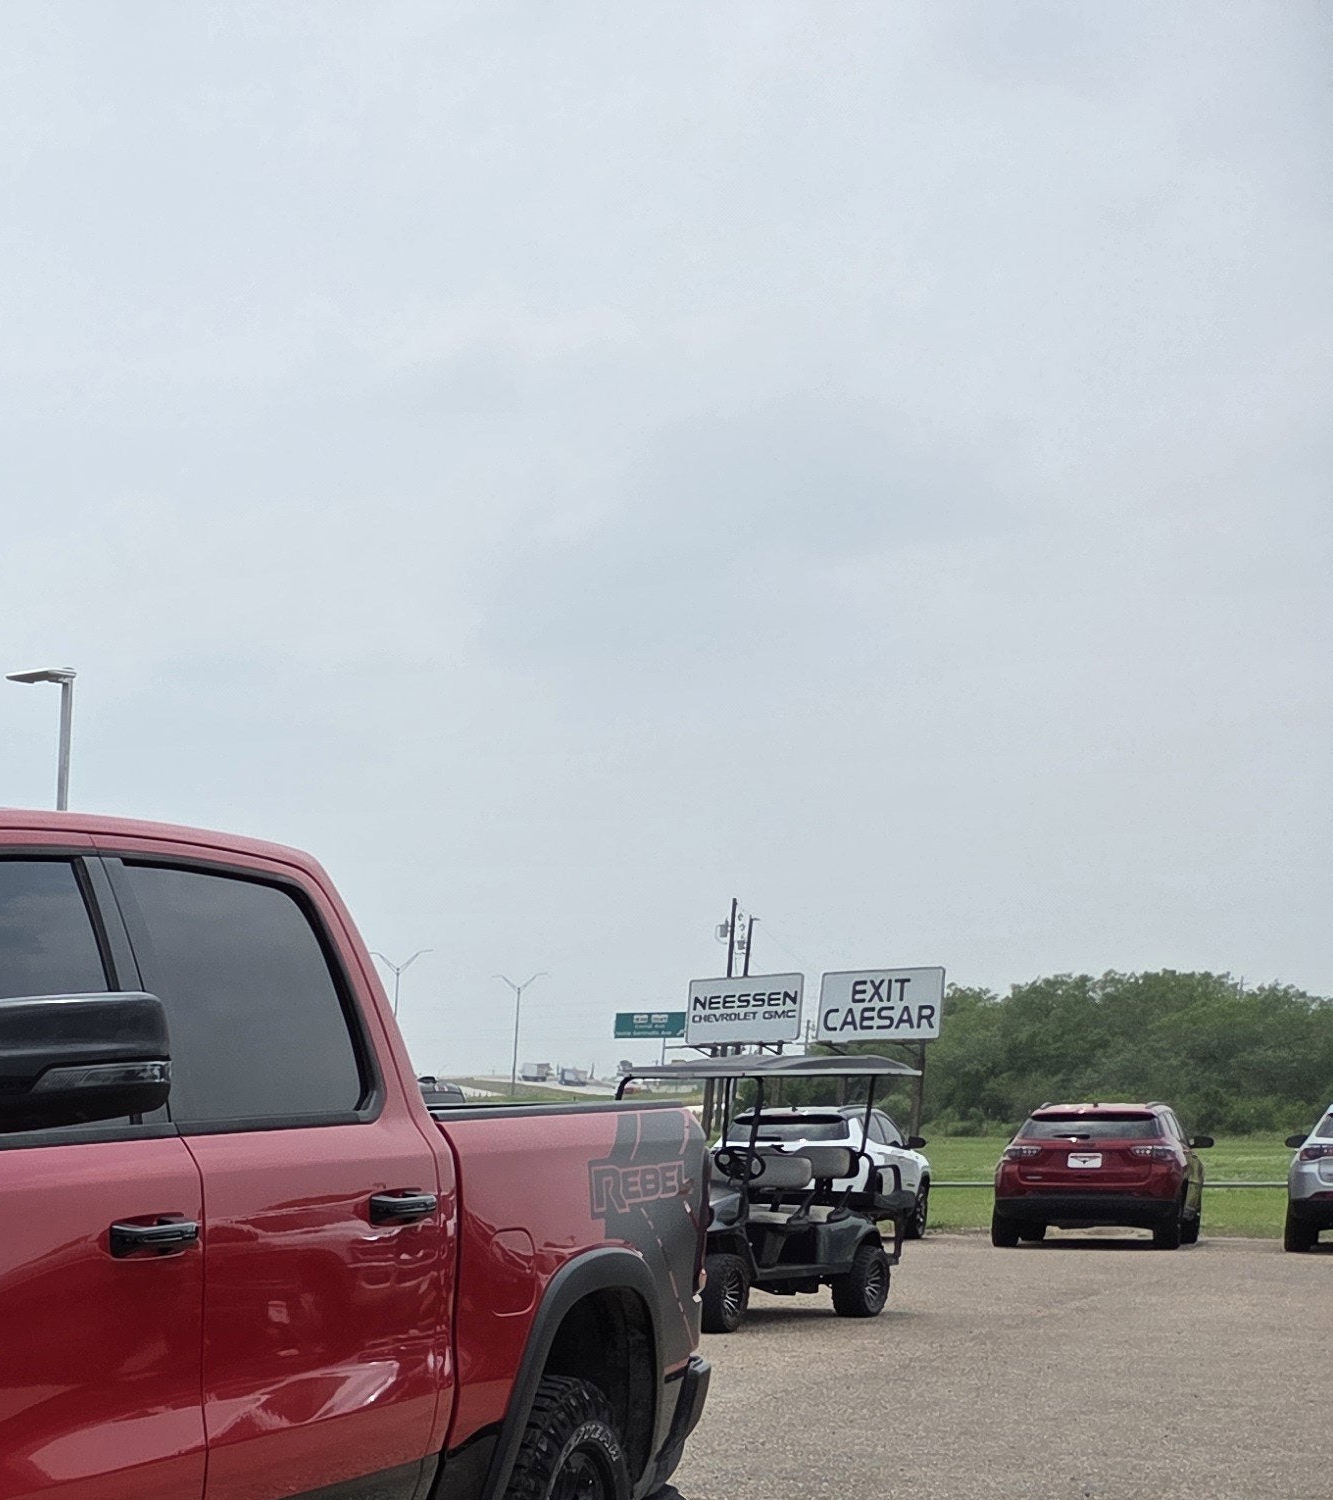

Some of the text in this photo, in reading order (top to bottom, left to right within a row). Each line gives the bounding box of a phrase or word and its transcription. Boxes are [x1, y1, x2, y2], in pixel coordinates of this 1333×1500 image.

[693, 990, 798, 1011] NEESSEN
[851, 978, 911, 1003] EXIT
[692, 1009, 797, 1024] CHEVROLET GMC
[823, 1005, 935, 1031] CAESAR
[592, 1161, 692, 1214] REBEL
